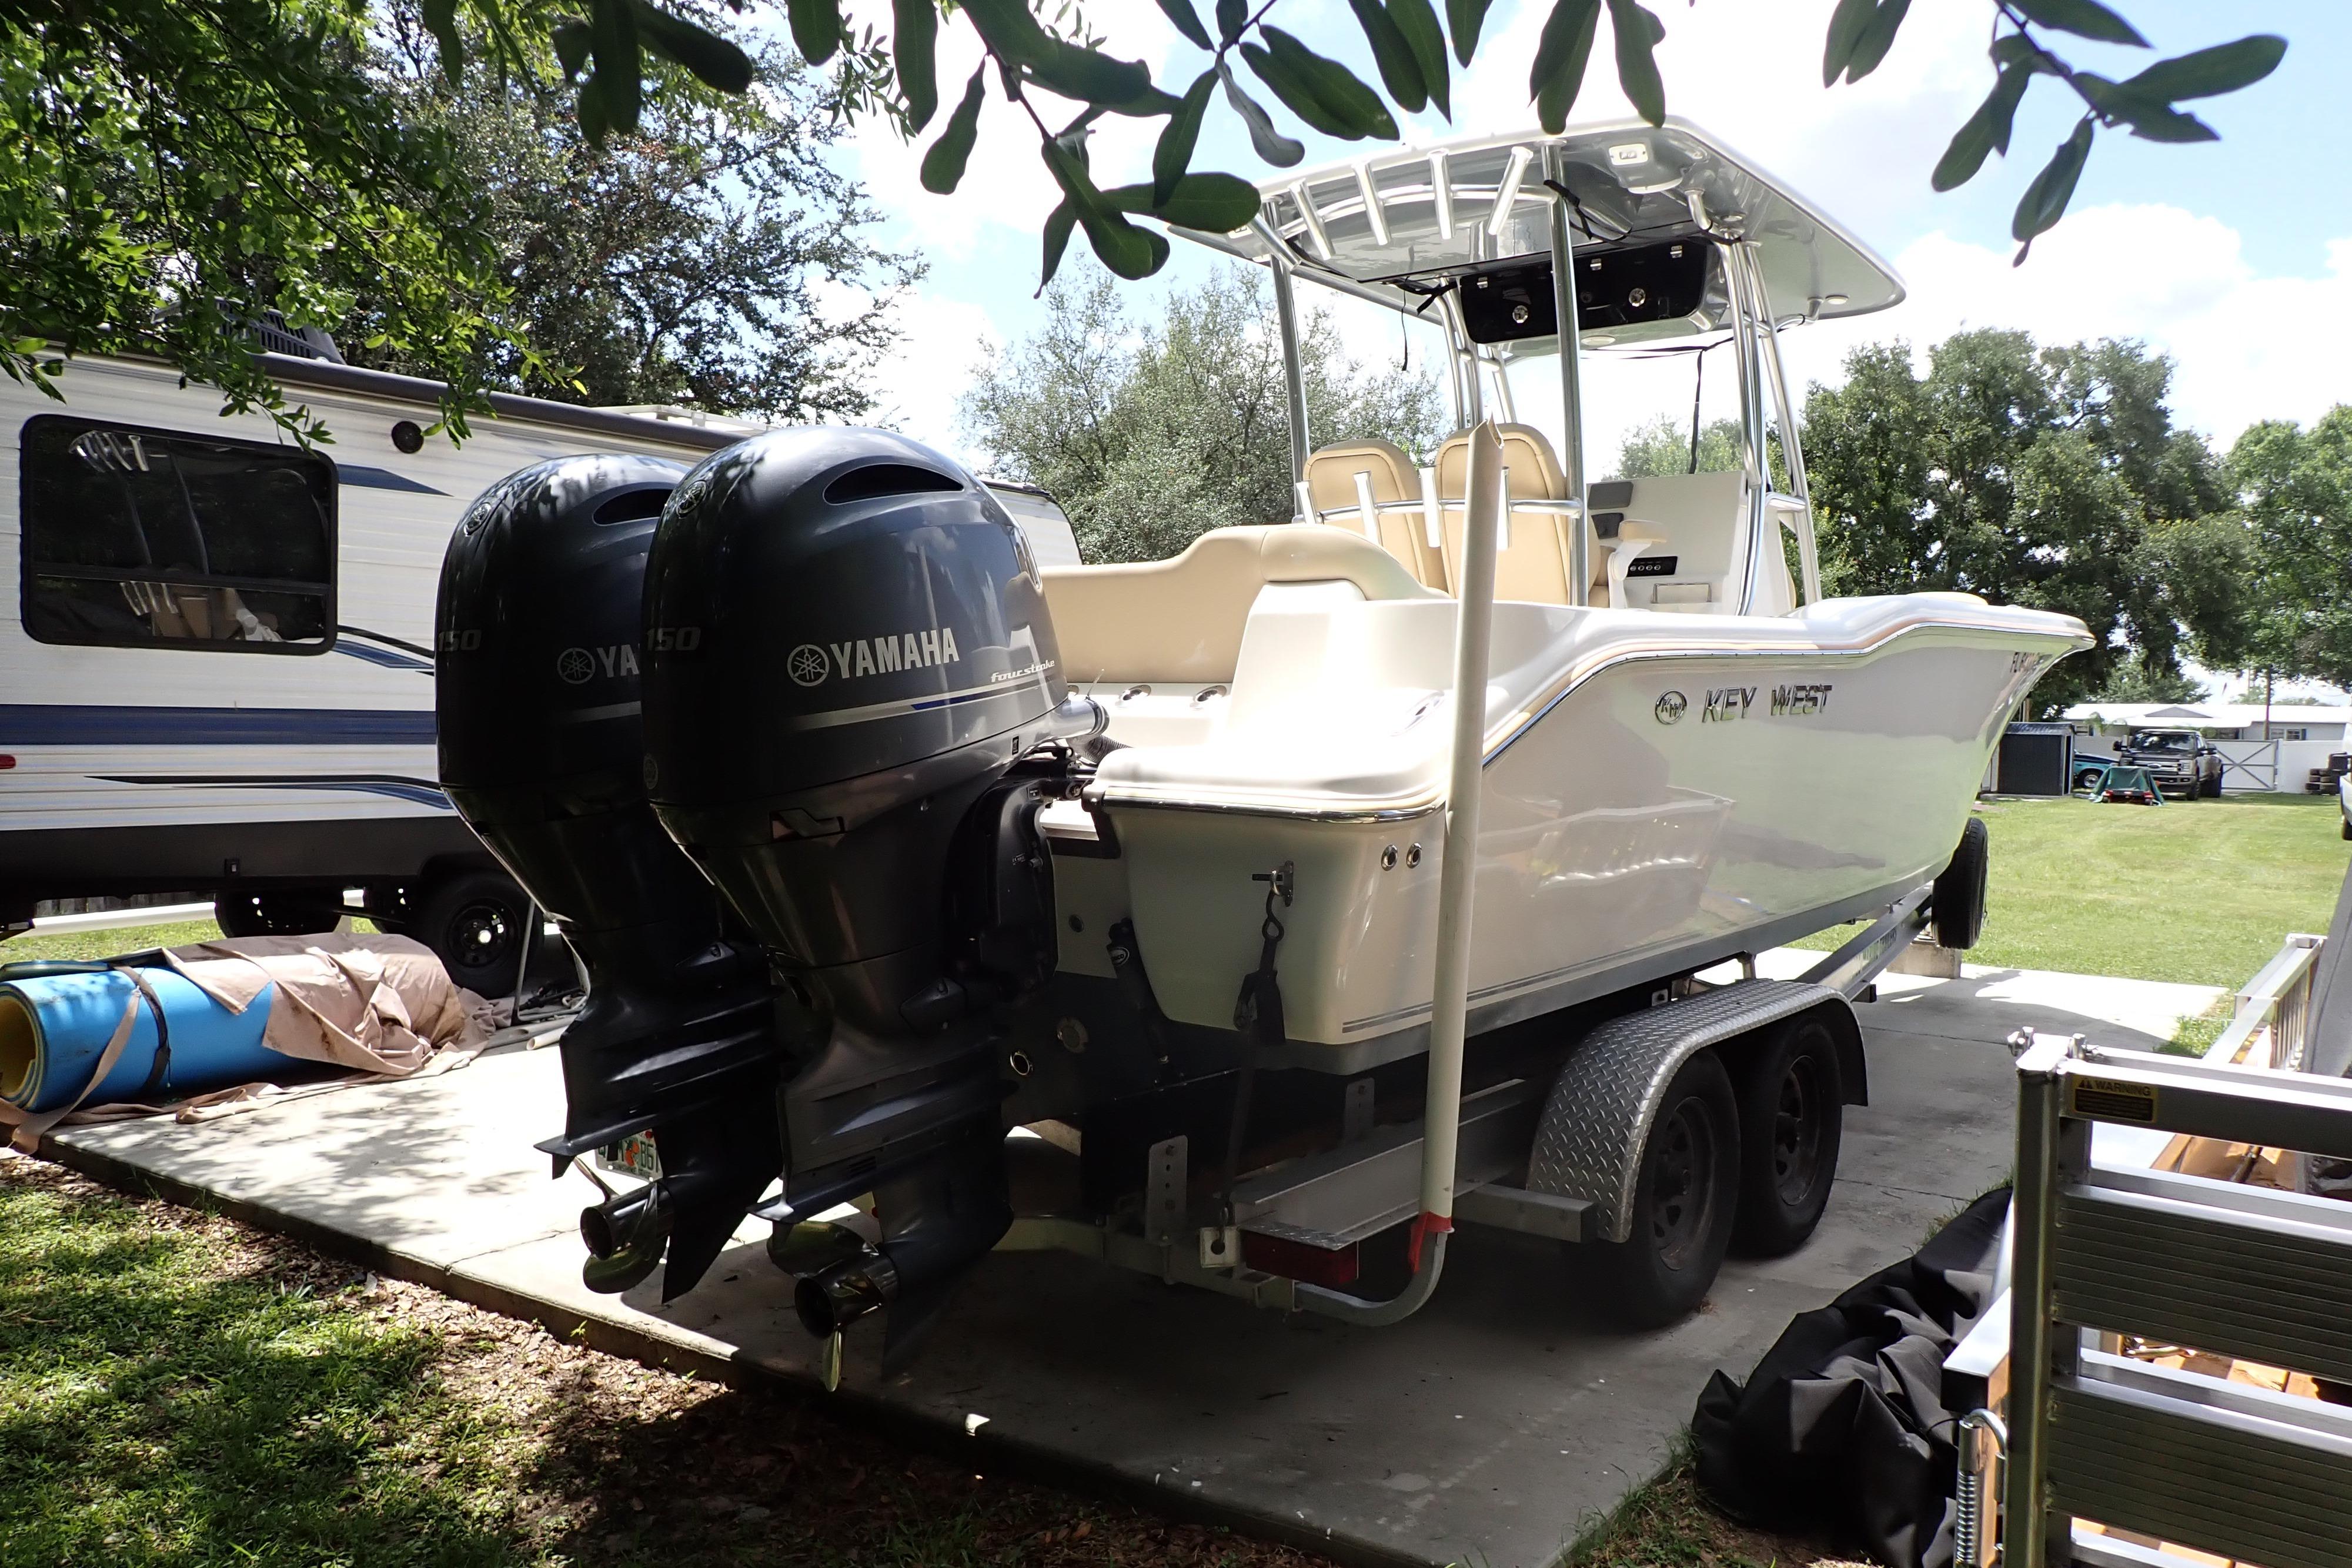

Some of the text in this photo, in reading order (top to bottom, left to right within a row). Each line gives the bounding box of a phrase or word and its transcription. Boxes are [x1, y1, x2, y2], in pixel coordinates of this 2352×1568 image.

[438, 629, 482, 652] 150
[646, 627, 701, 651] 150
[830, 627, 960, 679] YAMAHA
[596, 643, 640, 678] YA
[1702, 683, 1833, 723] KEY WEST
[2094, 1080, 2151, 1096] WARNING
